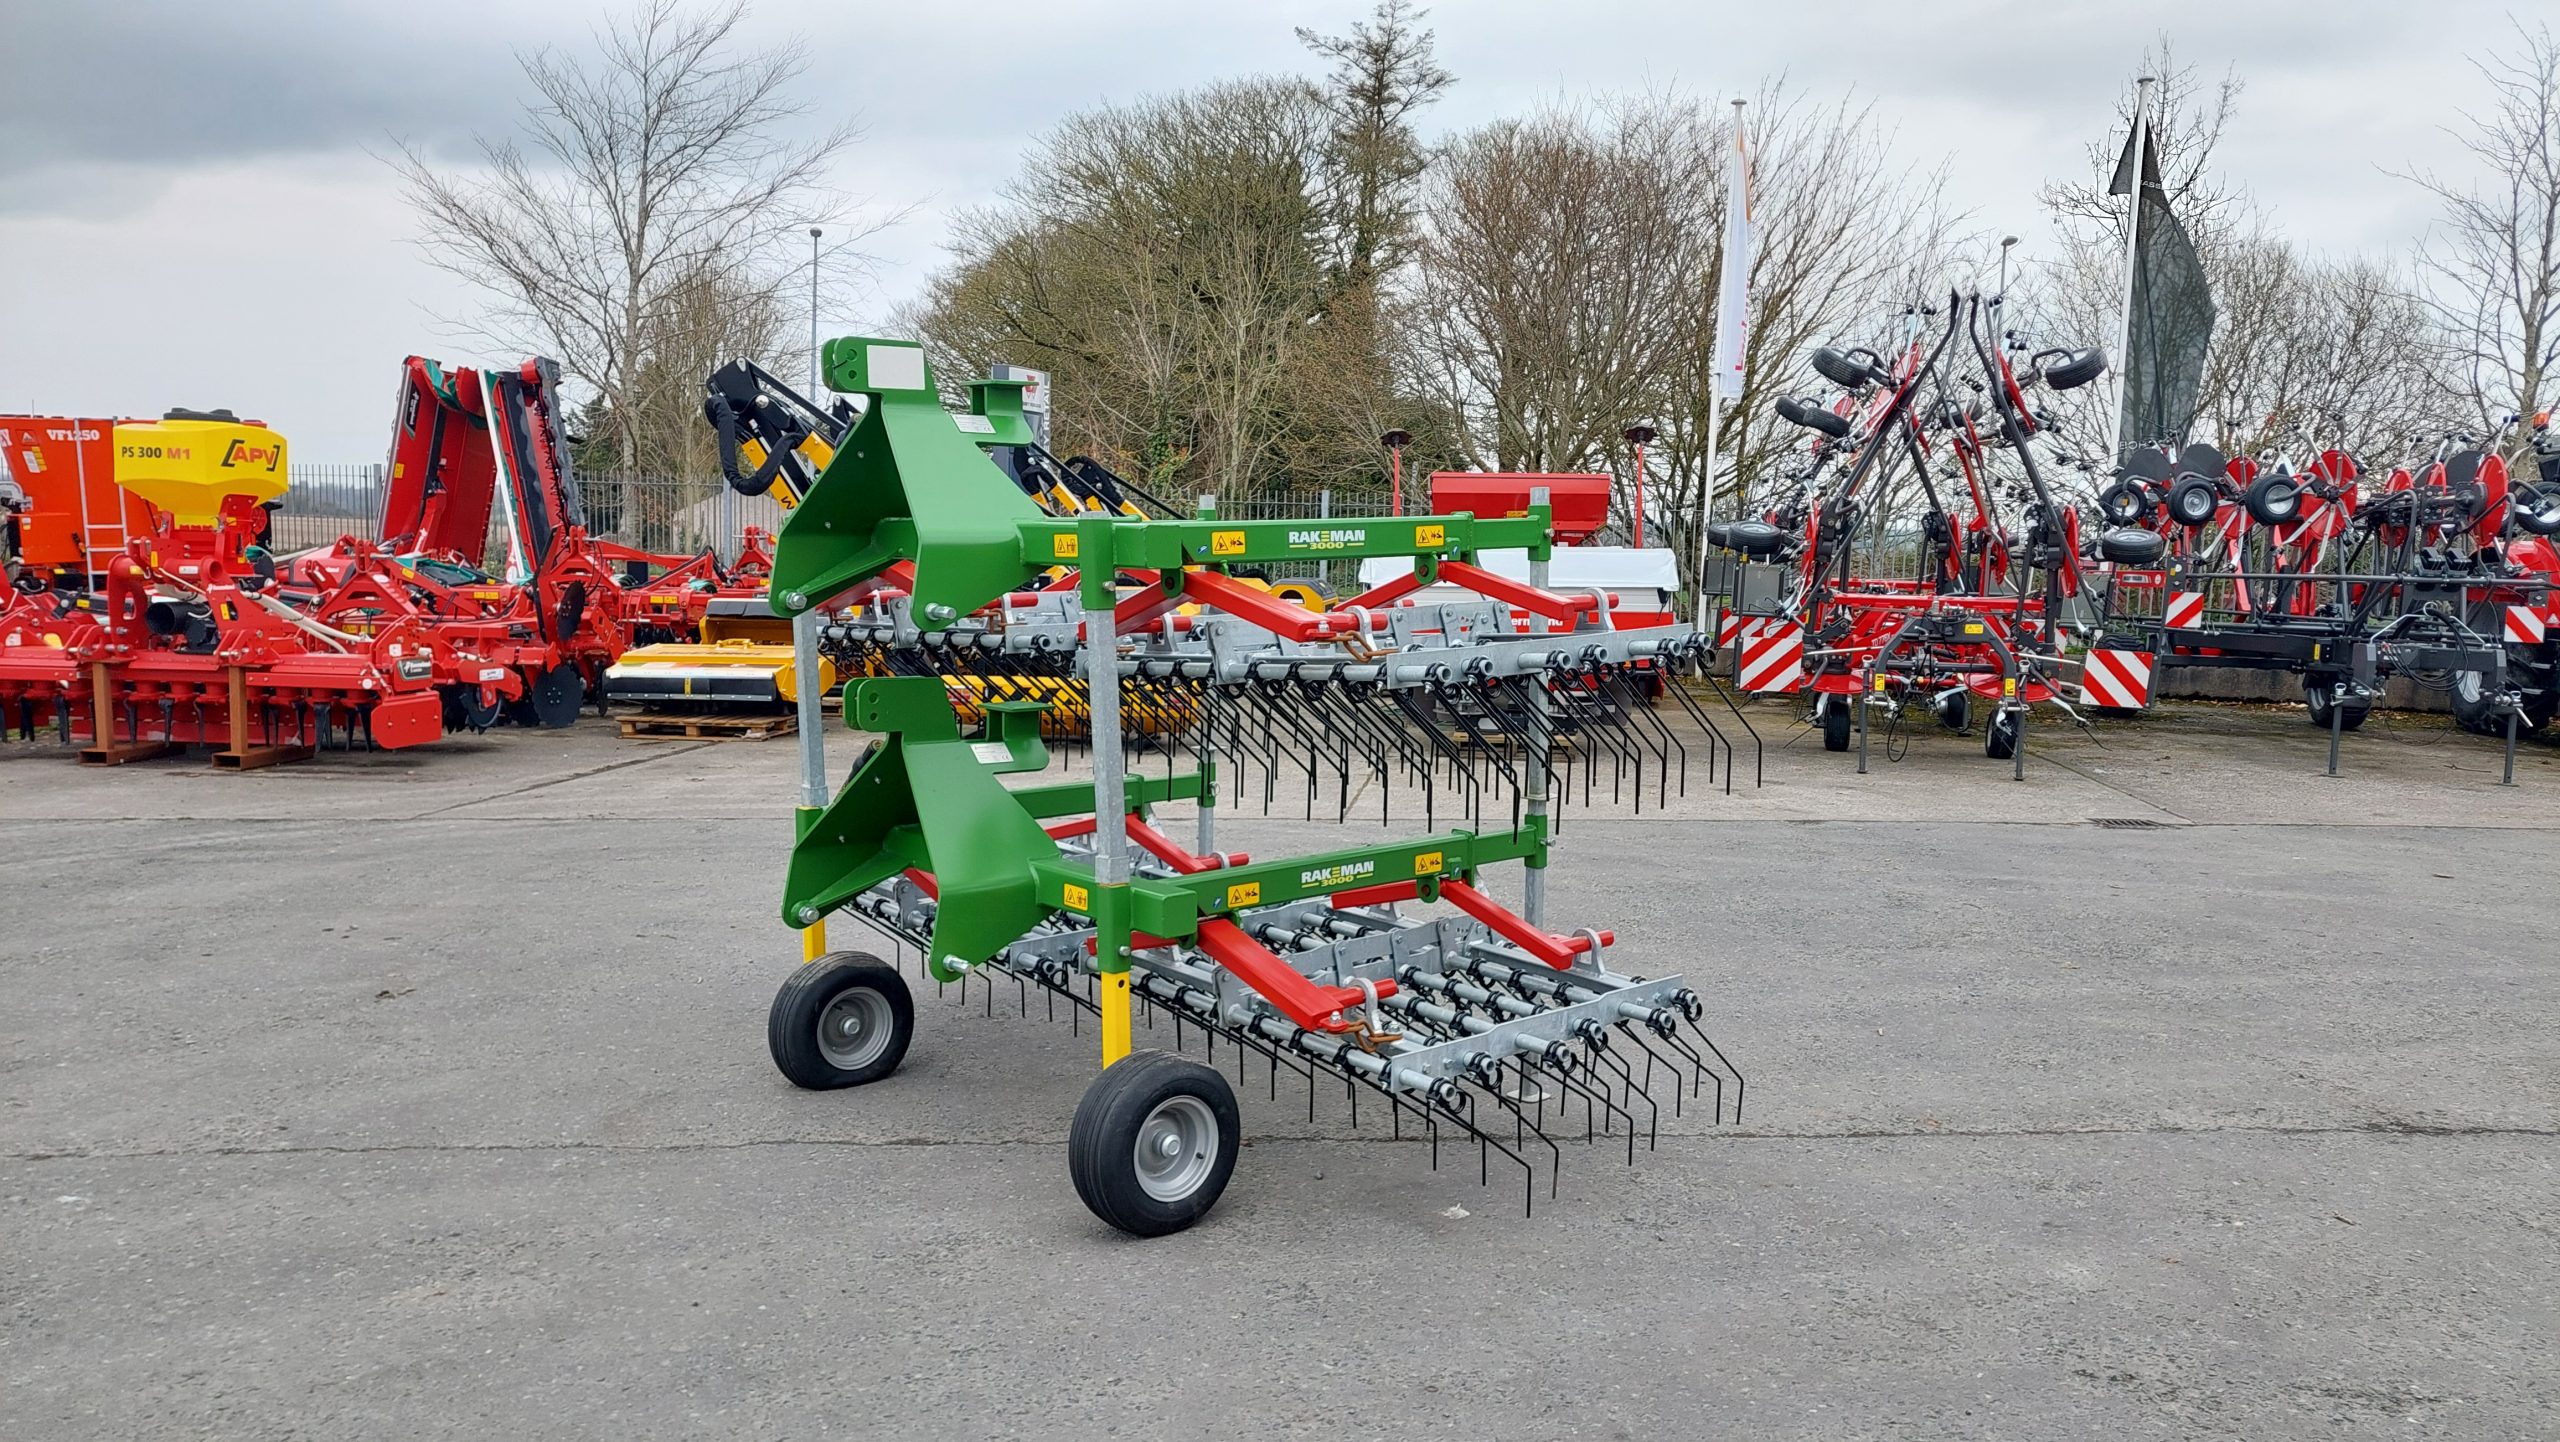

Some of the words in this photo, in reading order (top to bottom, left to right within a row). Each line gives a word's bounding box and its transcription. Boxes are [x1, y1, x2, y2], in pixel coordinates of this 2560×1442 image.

[121, 446, 135, 458] PS
[138, 446, 162, 459] 300
[167, 447, 190, 460] M1
[1288, 529, 1366, 544] RAKEMAN
[1309, 541, 1345, 550] 3000
[1301, 860, 1374, 884] RAKEMAN
[1320, 875, 1354, 887] 3000
